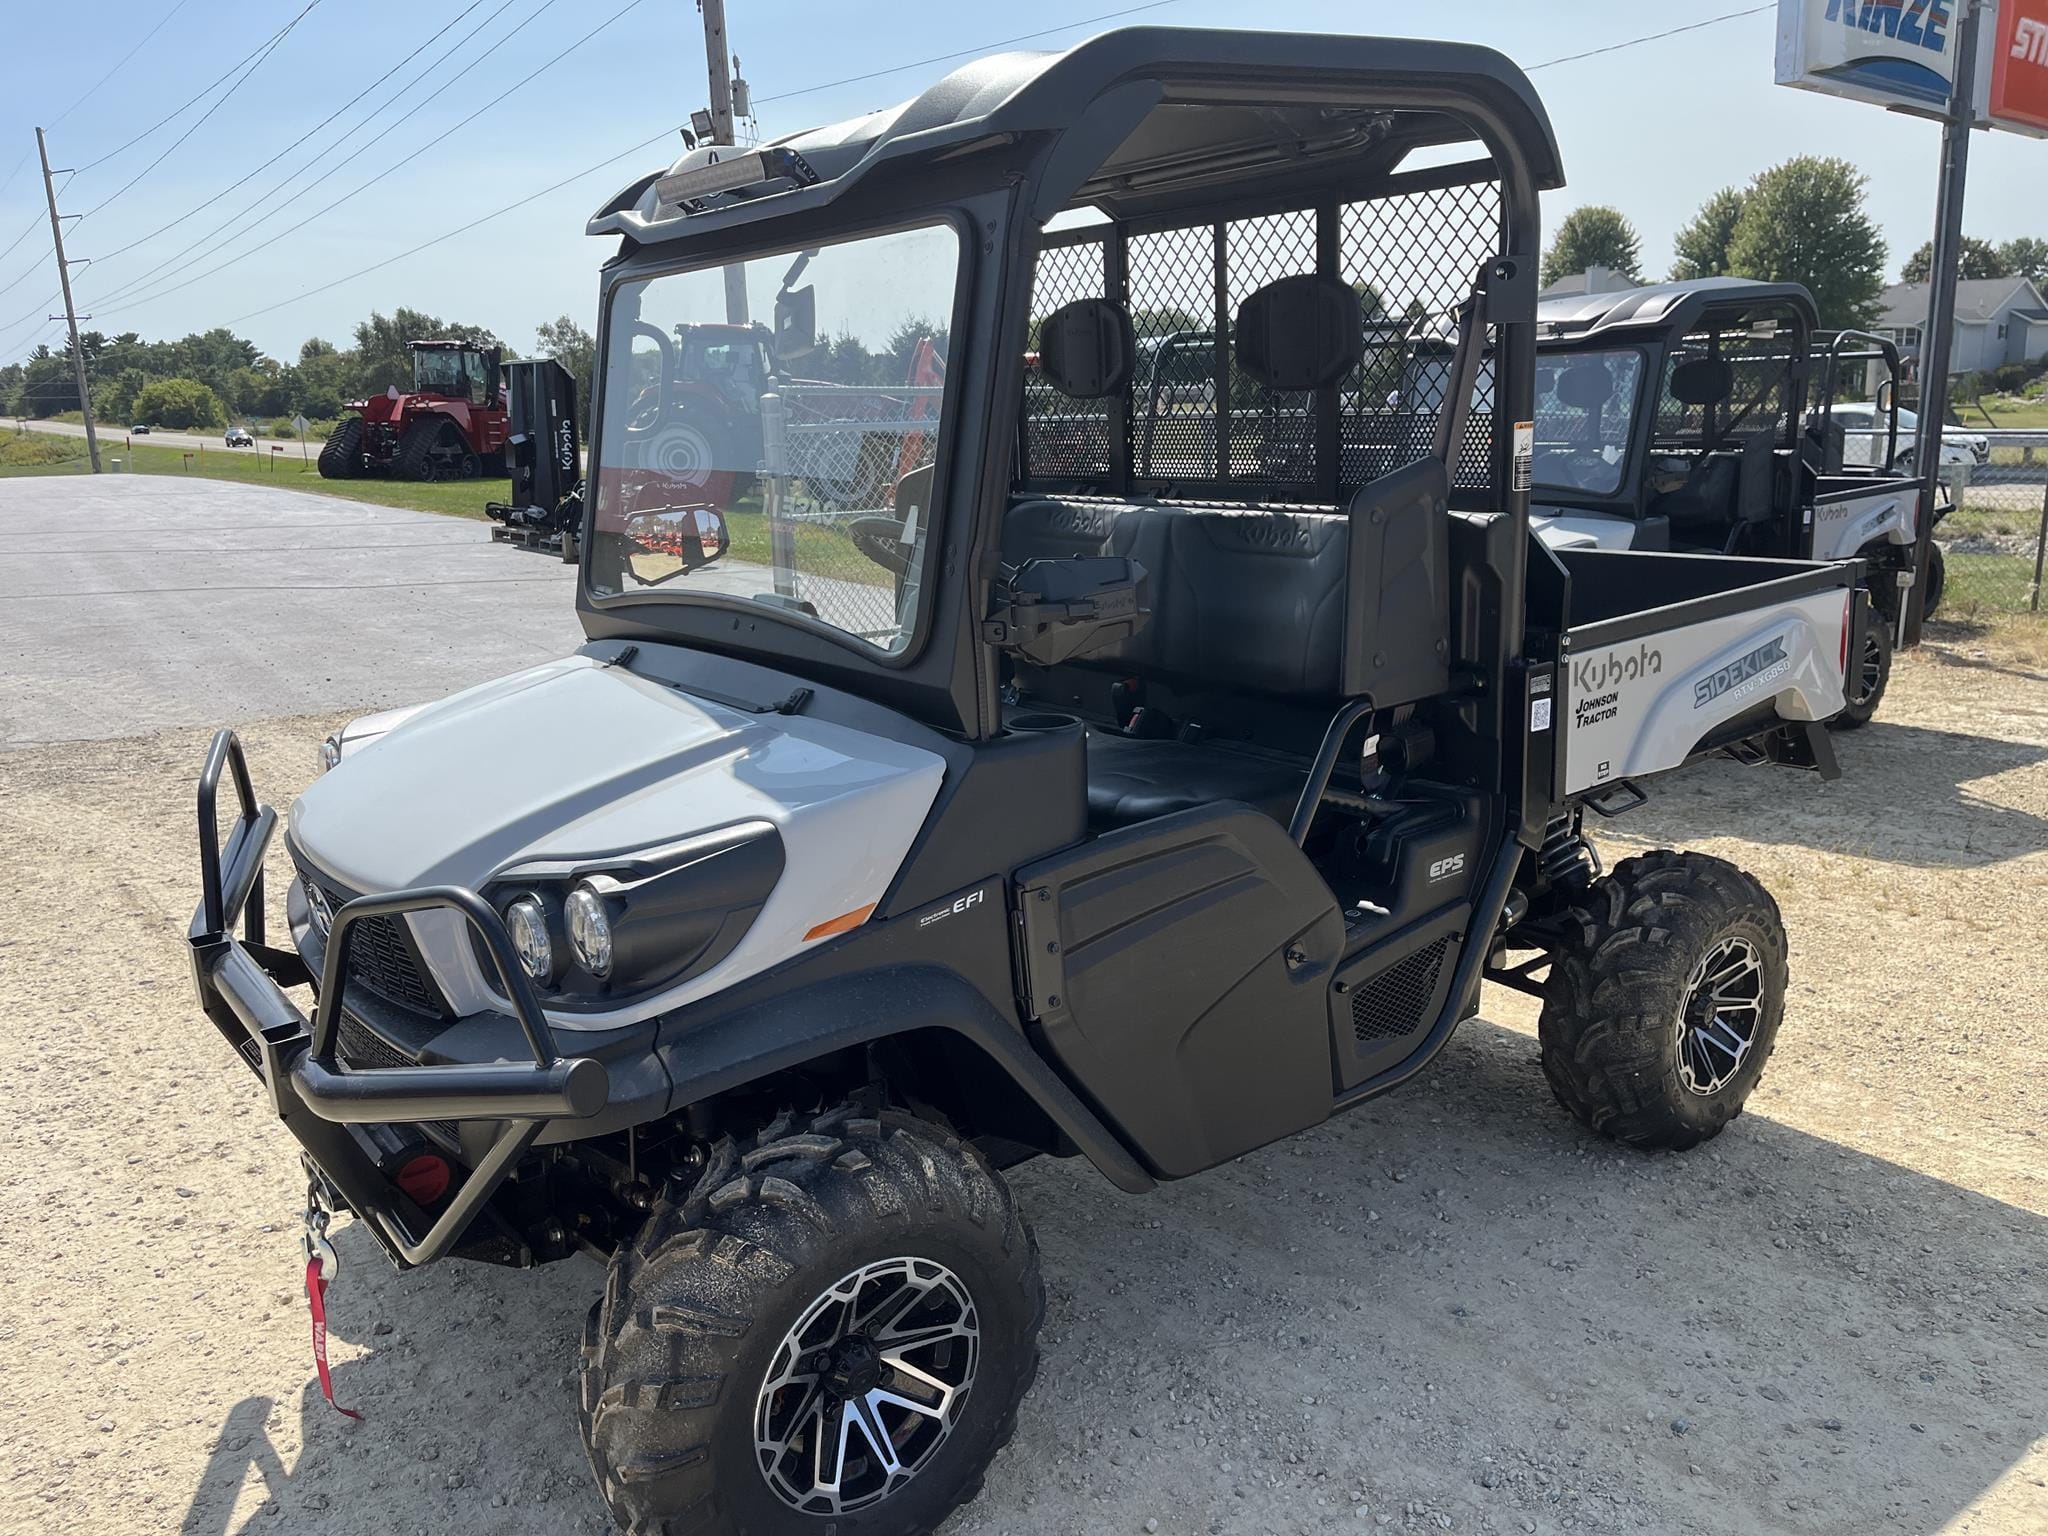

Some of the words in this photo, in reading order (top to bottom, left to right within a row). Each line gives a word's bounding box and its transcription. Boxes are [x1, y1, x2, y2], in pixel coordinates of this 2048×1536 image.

[2010, 16, 2048, 68] STI
[560, 419, 573, 470] Kubota
[1816, 504, 1848, 521] Kubota
[1573, 643, 1662, 693] Kubota
[1694, 636, 1787, 708] SIDEKICK
[1575, 691, 1619, 715] JOHNSON
[1576, 706, 1618, 729] TRACTOR
[1429, 853, 1465, 878] EPS
[953, 889, 984, 913] EFI
[314, 1321, 326, 1362] WARN
